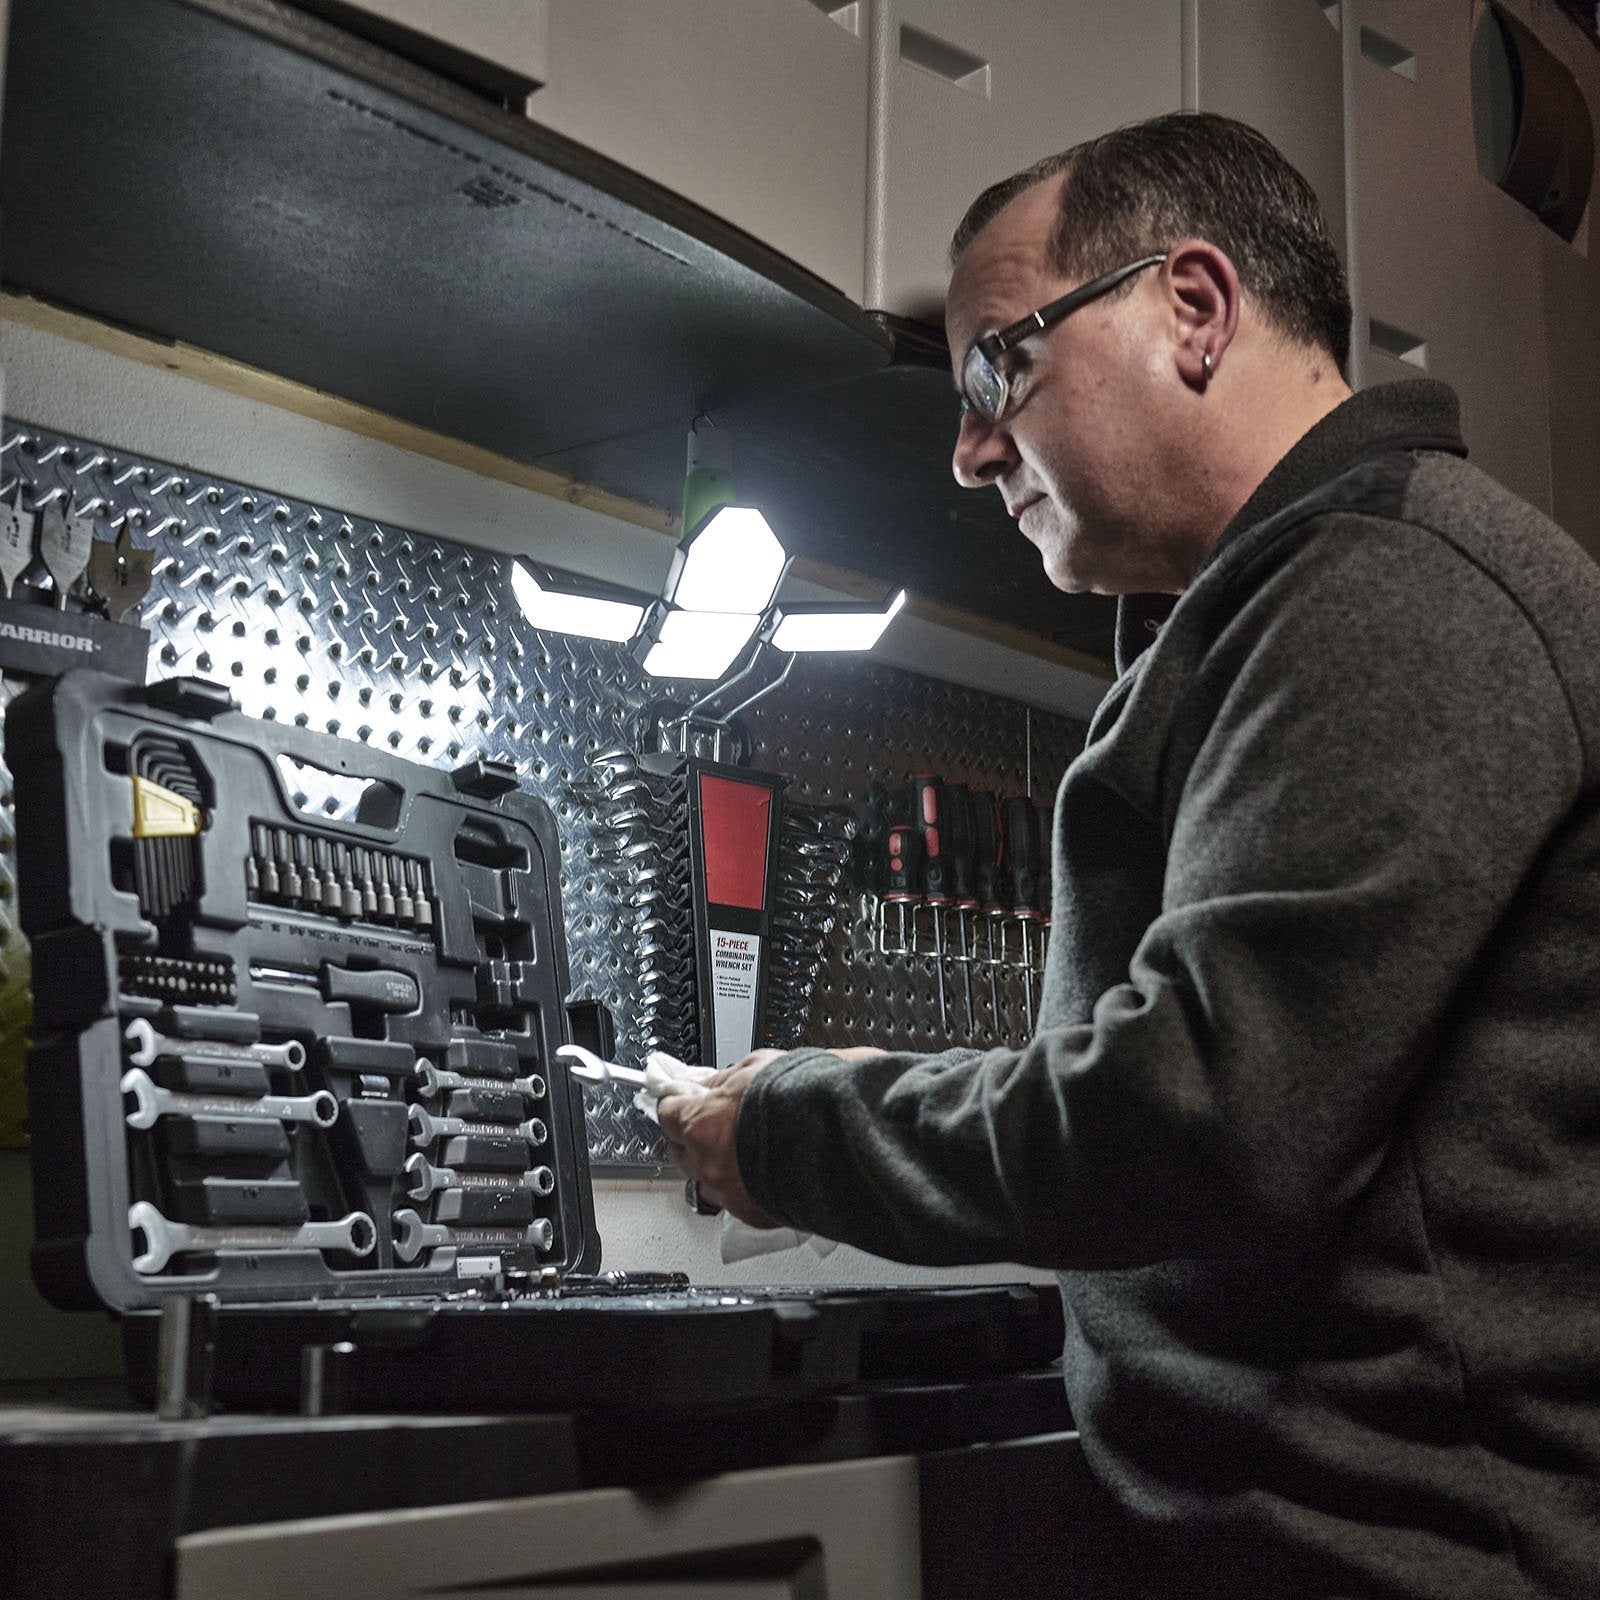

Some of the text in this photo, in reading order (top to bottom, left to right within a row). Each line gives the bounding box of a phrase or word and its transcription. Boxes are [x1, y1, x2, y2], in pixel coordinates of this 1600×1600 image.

[0, 622, 94, 653] ARRIOR
[717, 937, 749, 951] 15-PIECE
[715, 950, 755, 962] COMBINATION
[715, 960, 752, 971] WRENCH SET
